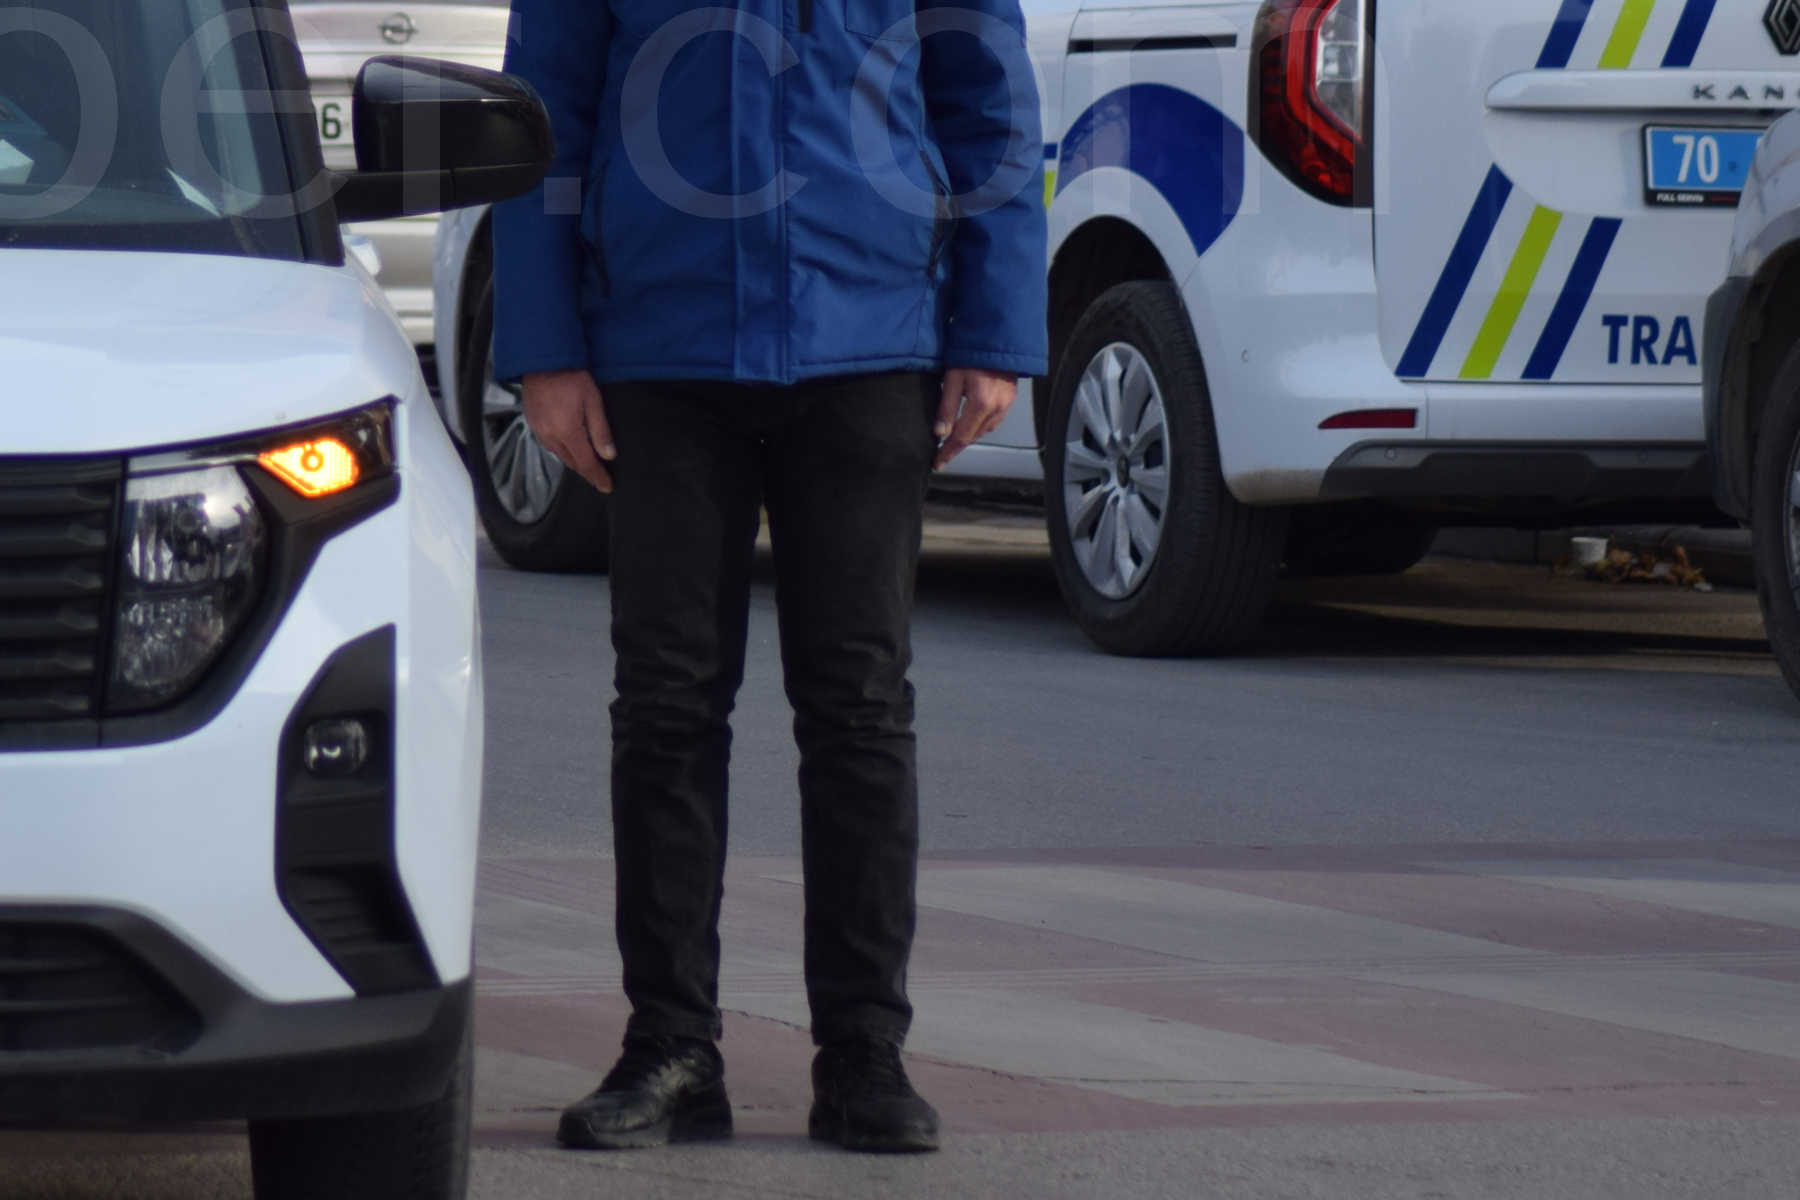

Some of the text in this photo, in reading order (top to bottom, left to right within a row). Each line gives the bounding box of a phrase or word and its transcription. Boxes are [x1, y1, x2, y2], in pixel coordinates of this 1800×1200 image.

[1692, 84, 1800, 101] KAN
[1672, 135, 1720, 183] 70
[1602, 316, 1697, 365] TRA
